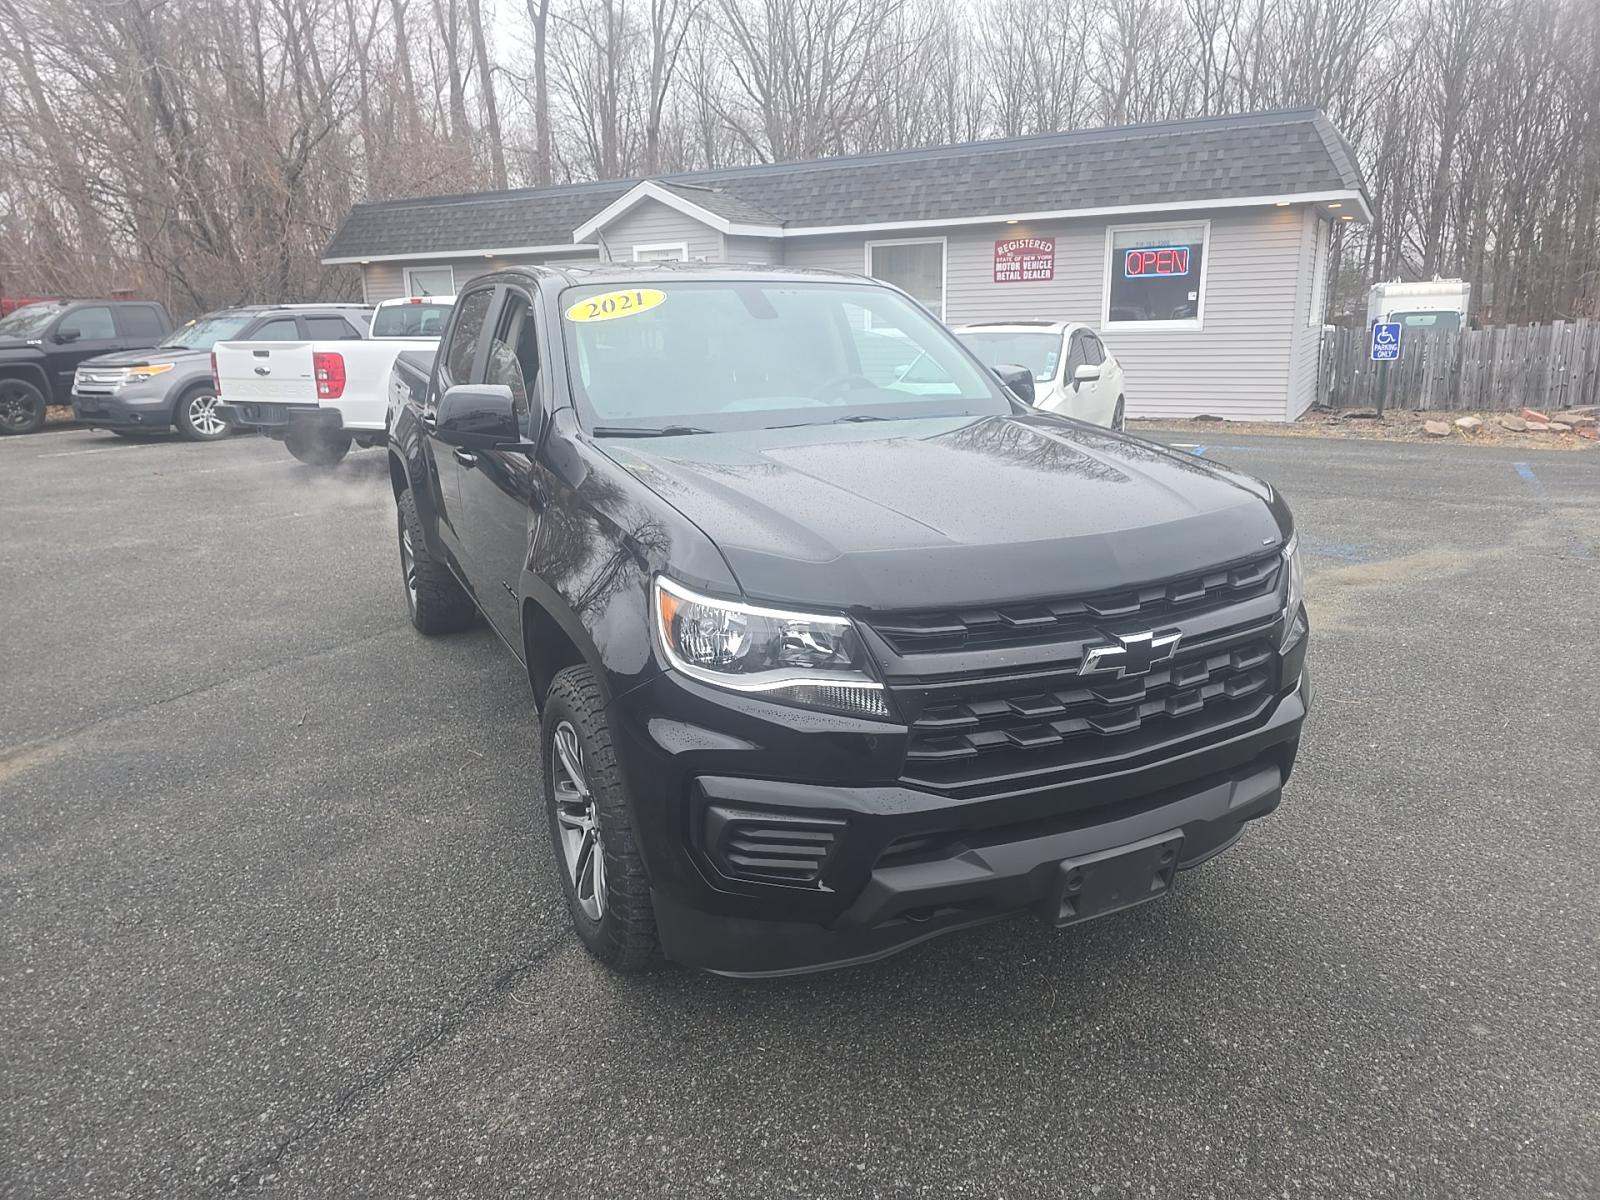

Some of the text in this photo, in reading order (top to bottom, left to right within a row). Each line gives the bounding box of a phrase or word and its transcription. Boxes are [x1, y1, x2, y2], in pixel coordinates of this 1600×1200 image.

[998, 240, 1052, 255] REGISTERED
[996, 260, 1052, 272] MOTOR VEHICLE
[1127, 250, 1187, 276] OPEN
[996, 270, 1050, 280] RETAIL DEALER
[586, 292, 643, 318] 2021
